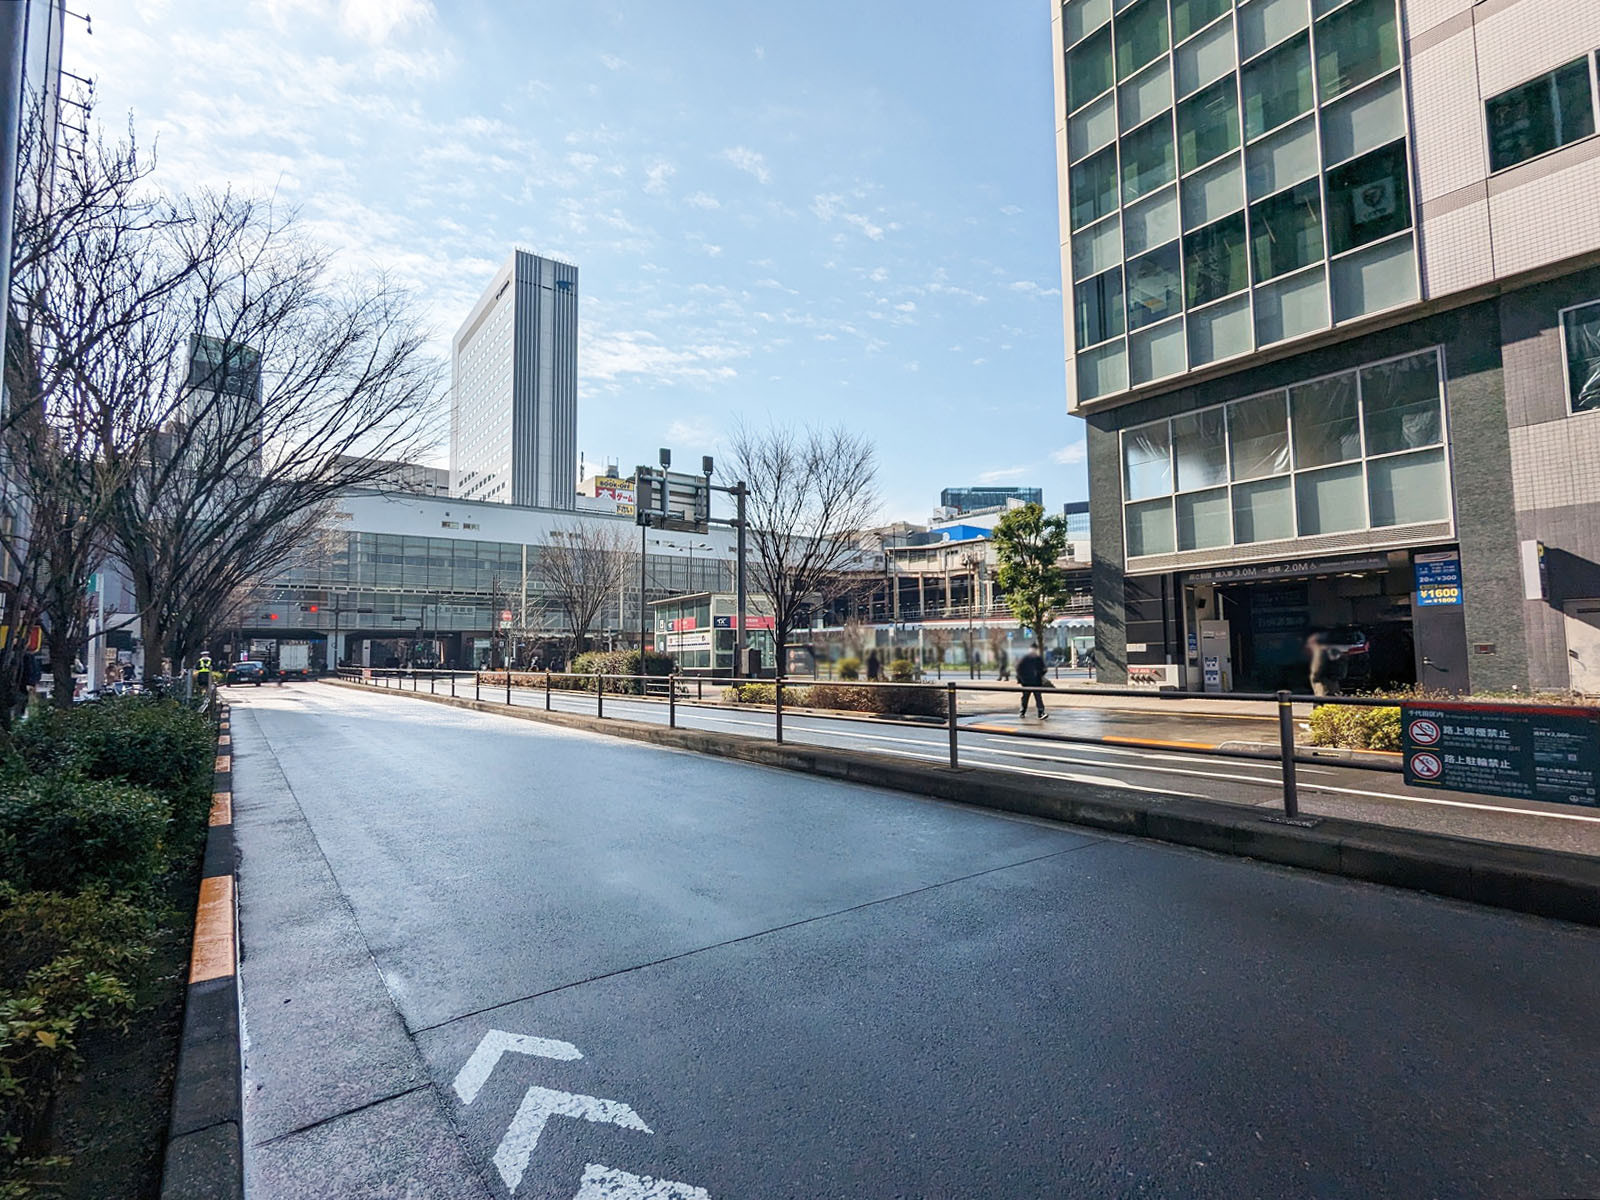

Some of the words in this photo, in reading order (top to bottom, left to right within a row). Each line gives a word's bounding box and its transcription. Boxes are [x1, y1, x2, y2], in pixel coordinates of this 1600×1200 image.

[617, 492, 633, 502] ゲーム
[1235, 567, 1257, 577] 3.0M
[1284, 563, 1308, 572] 2.0M
[1420, 588, 1458, 598] ¥1600
[1443, 725, 1511, 739] 路上喫煙禁止
[1444, 754, 1512, 769] 路上駐輪禁止
